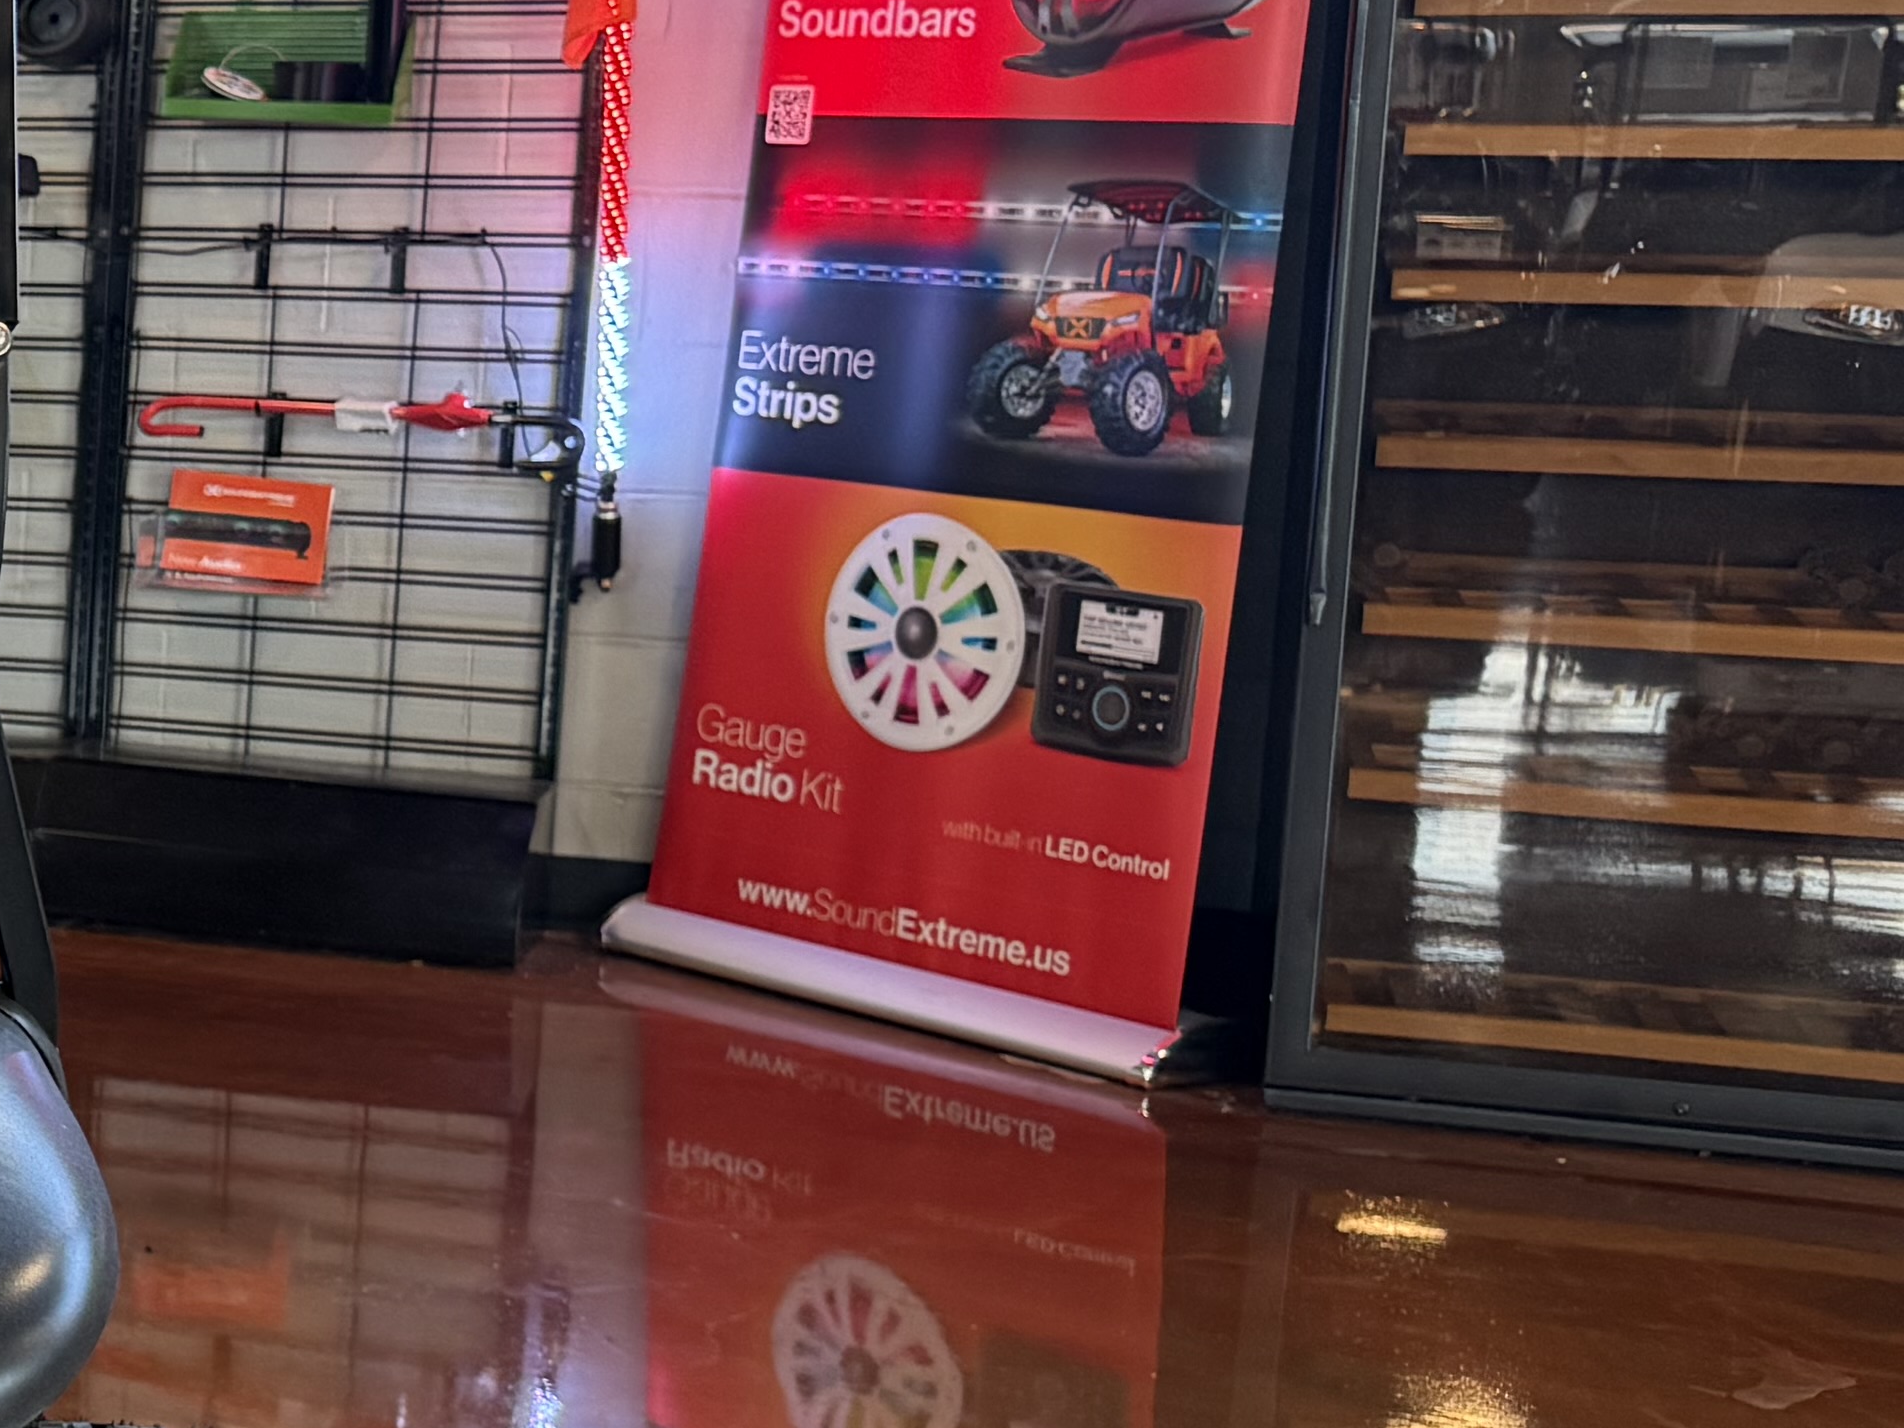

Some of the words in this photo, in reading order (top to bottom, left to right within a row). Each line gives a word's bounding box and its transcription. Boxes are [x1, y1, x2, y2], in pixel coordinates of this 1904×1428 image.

[736, 329, 876, 381] Extreme
[731, 377, 841, 428] Strips
[695, 702, 808, 764] Gauge
[692, 749, 795, 803] Radio
[799, 768, 846, 814] Kit
[1045, 834, 1090, 864] LED
[1091, 844, 1171, 882] Control
[736, 876, 1072, 977] www.SoundExtreme.us
